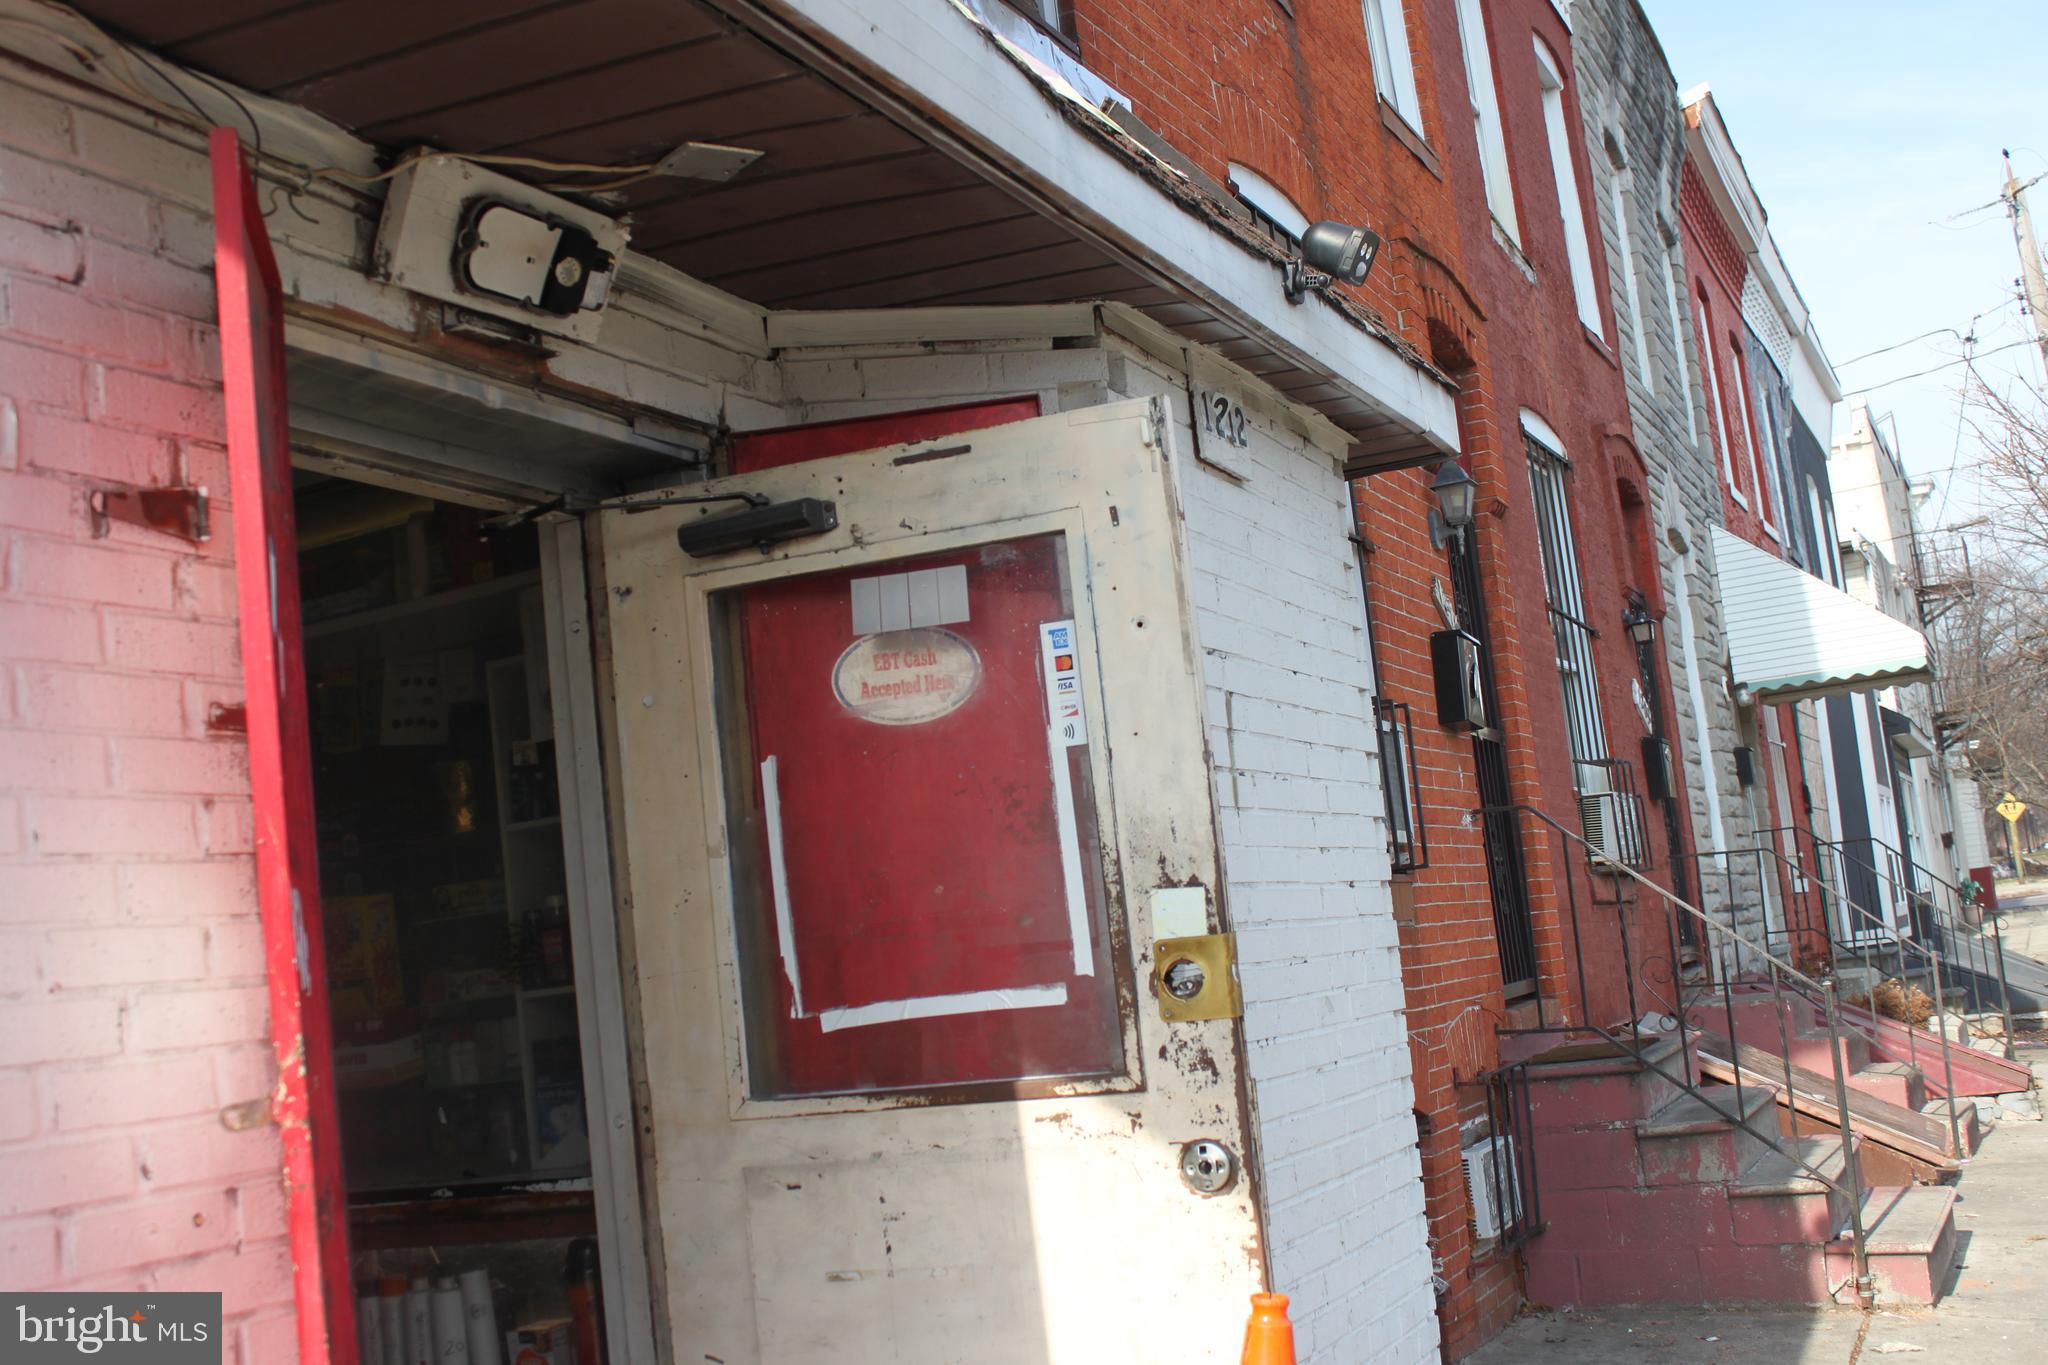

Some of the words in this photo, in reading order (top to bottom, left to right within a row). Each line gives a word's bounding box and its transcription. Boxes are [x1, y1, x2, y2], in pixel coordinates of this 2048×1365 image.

[1201, 391, 1248, 448] 1212
[1054, 631, 1068, 640] AM
[873, 651, 900, 672] EBT
[904, 648, 937, 668] Cash
[861, 674, 922, 699] Accepted
